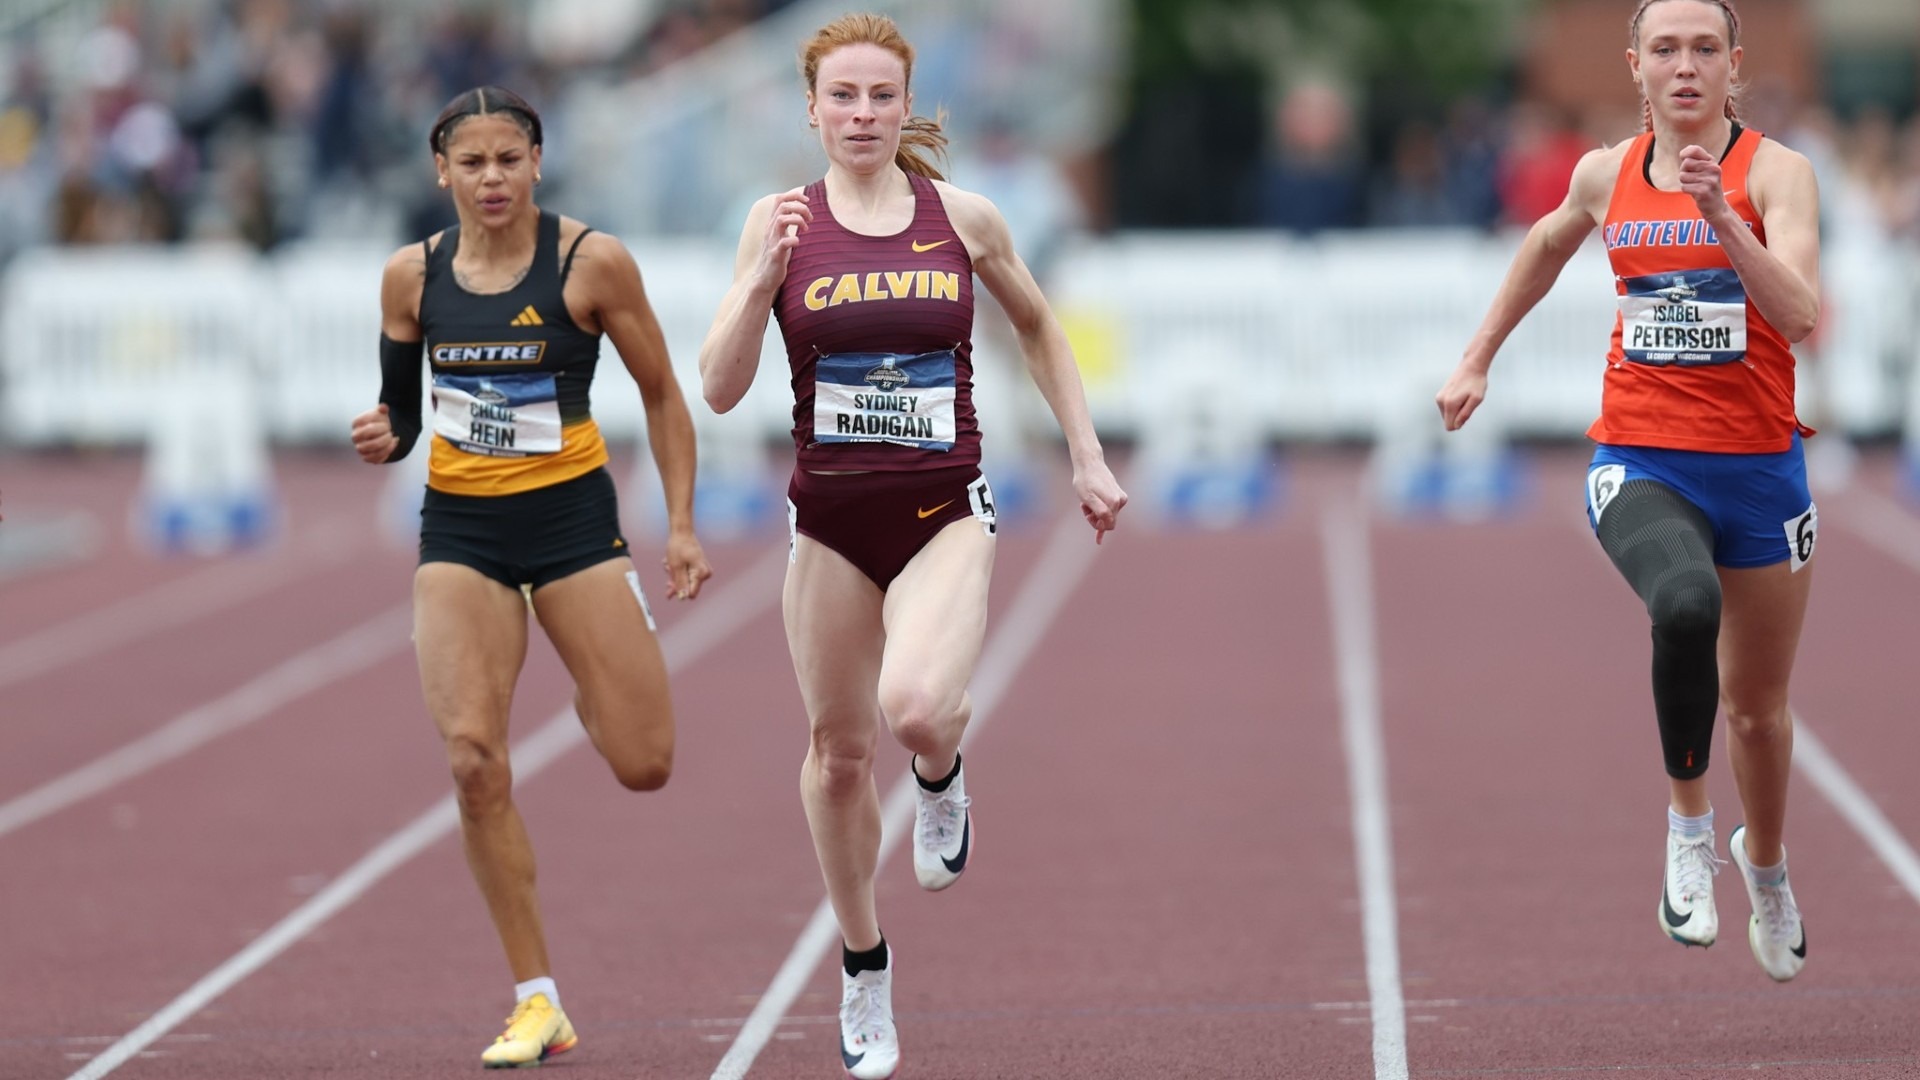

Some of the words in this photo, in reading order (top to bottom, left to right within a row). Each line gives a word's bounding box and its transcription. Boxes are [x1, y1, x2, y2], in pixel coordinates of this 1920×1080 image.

[1605, 218, 1752, 251] LATTEVIL
[804, 270, 959, 311] CALVIN
[1653, 305, 1703, 323] ISABEL
[1633, 325, 1731, 349] PETERSON
[434, 345, 539, 362] CENTRE
[854, 393, 918, 413] SYDNEY
[470, 421, 515, 448] HEIN
[836, 413, 933, 439] RADIGAN
[1595, 466, 1614, 510] 6
[976, 483, 997, 533] 5
[1796, 512, 1814, 562] 6
